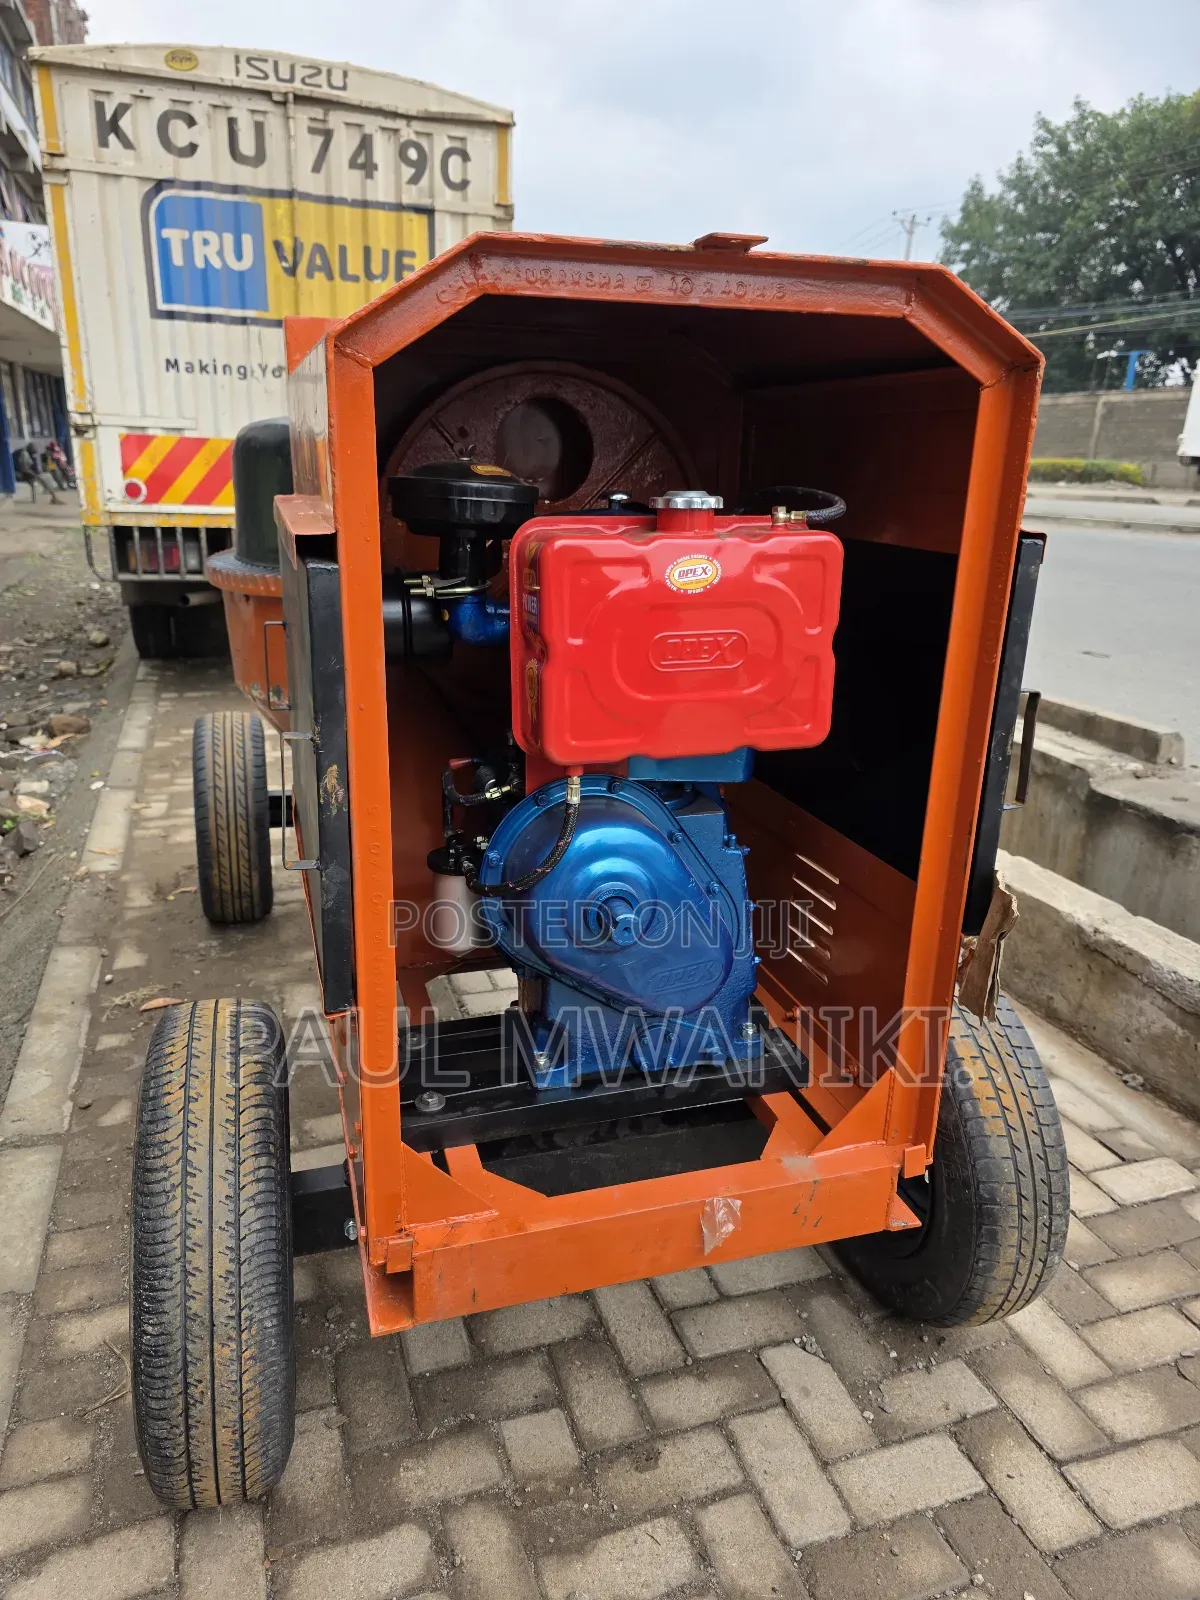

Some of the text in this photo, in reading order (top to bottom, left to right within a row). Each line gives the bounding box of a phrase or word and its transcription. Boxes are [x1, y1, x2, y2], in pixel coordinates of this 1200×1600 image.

[234, 54, 349, 92] ISUZU
[94, 101, 472, 191] KCU 749C
[161, 228, 254, 272] TRU
[273, 236, 417, 284] VALUE
[165, 358, 248, 380] Making
[677, 565, 709, 579] OPEX
[660, 636, 738, 664] OPEX
